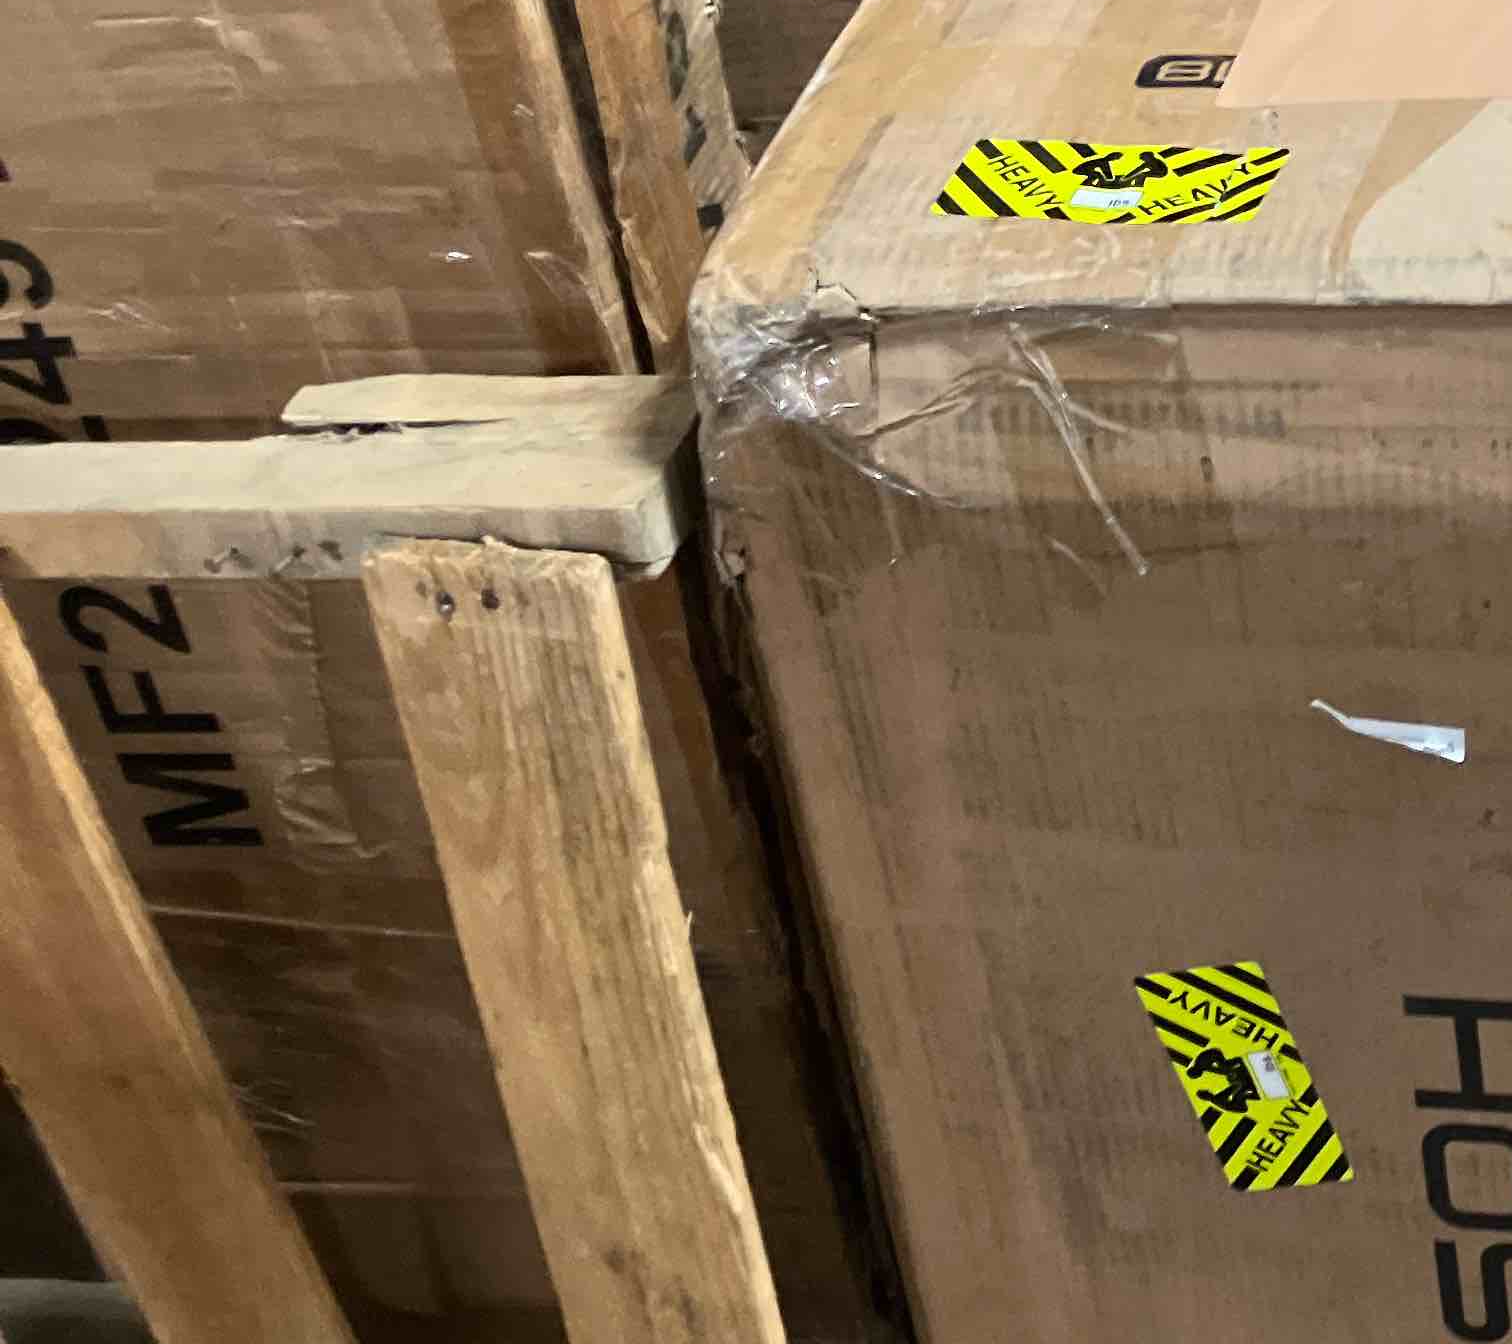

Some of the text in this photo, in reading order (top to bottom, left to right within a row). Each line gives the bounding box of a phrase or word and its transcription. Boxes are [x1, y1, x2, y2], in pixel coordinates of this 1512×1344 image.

[987, 153, 1065, 210] HEAVY
[1138, 162, 1253, 217] HEAVY
[1168, 990, 1280, 1049] HEAVY
[1246, 1098, 1310, 1173] HEAVY
